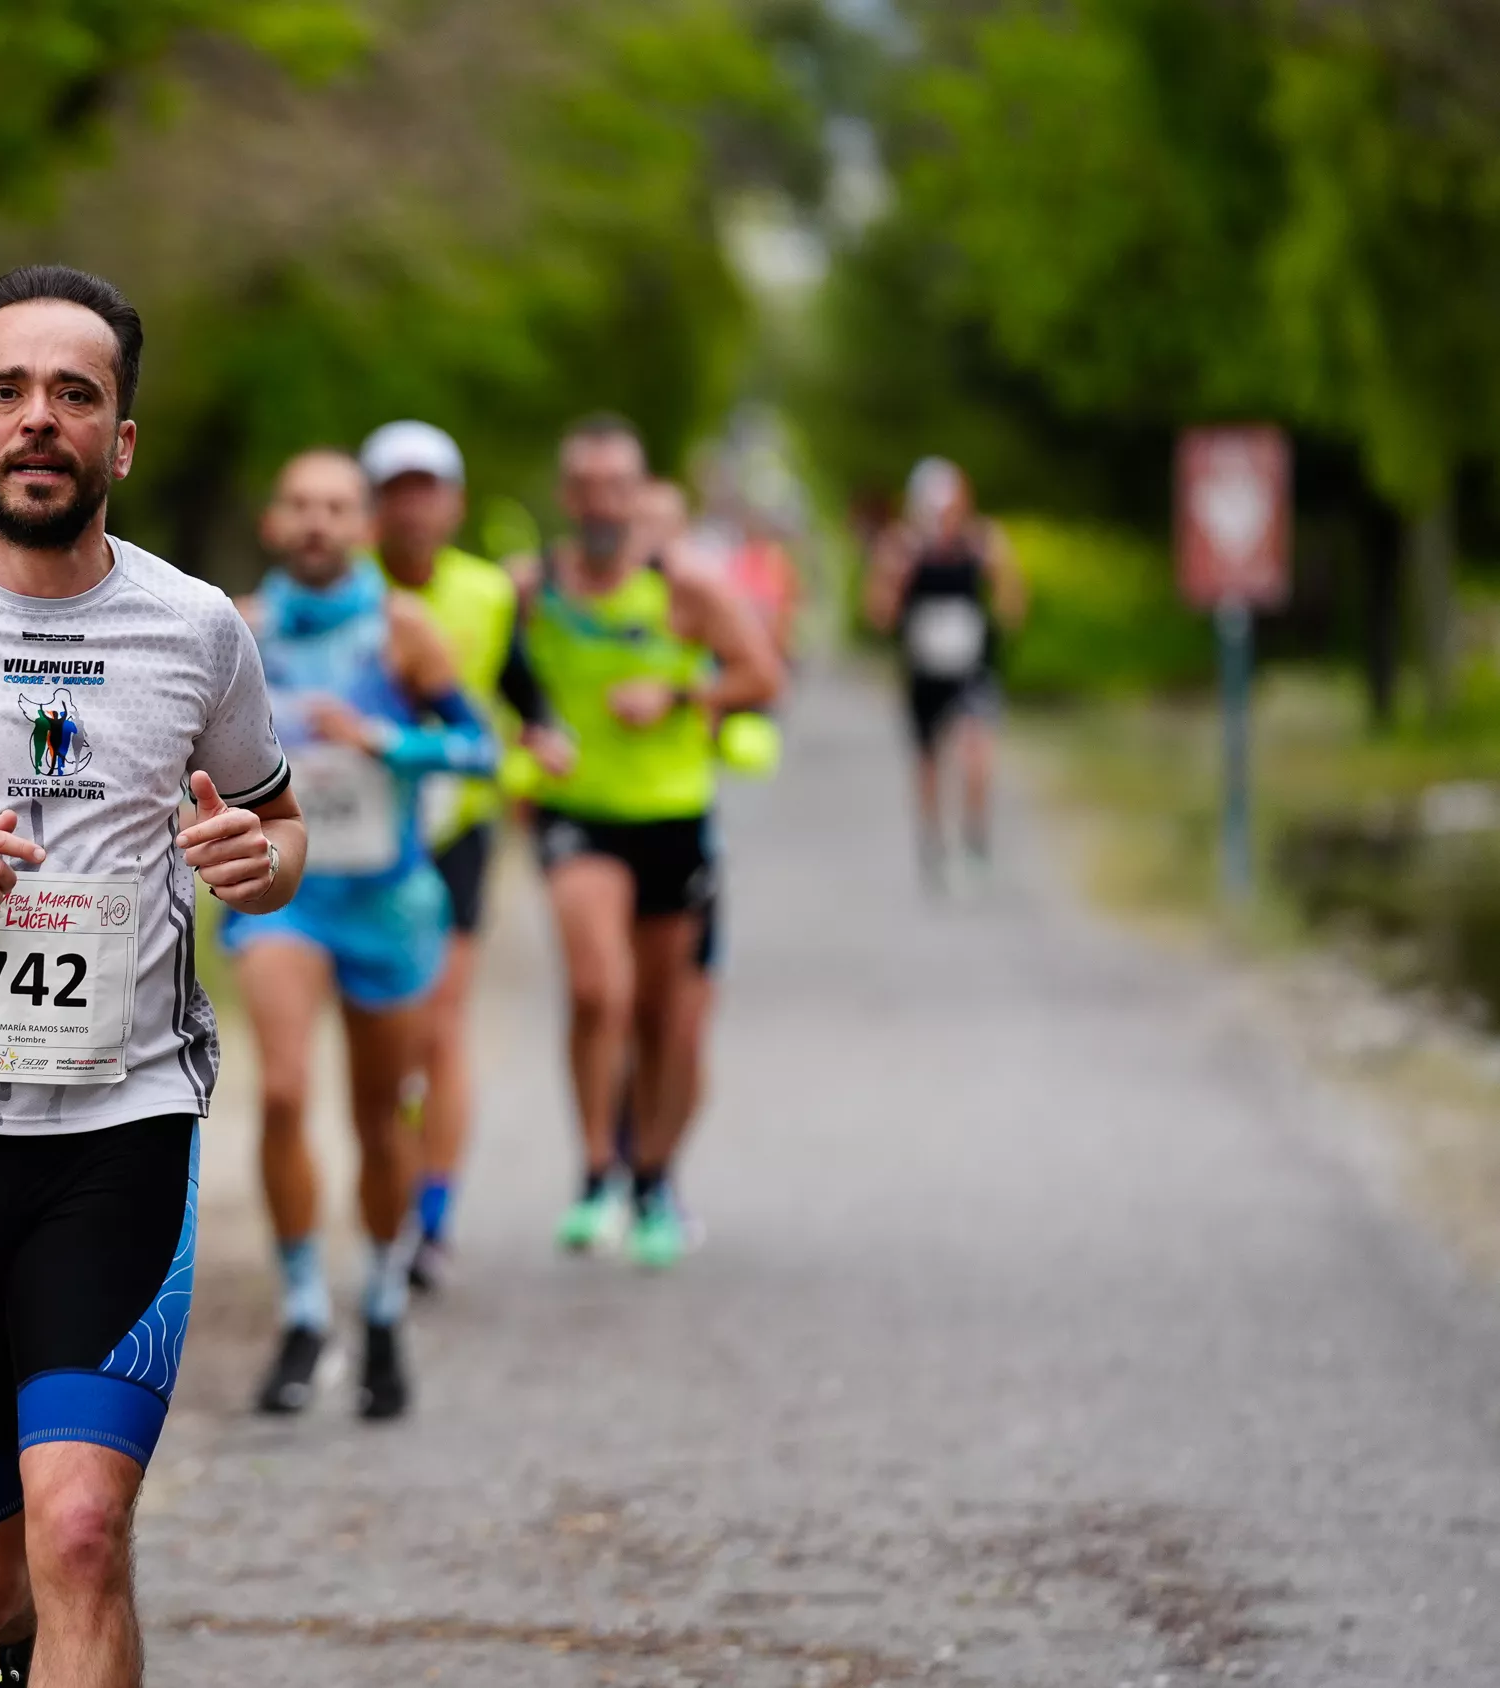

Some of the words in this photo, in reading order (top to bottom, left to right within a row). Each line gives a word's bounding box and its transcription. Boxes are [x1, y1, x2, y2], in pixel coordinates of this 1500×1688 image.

[3, 658, 105, 674] VILLANUEVA
[63, 676, 105, 685] MUCHO
[8, 778, 47, 786] VILLANUEVA
[78, 780, 105, 788] SERENA
[7, 786, 105, 800] EXTREMADURA
[37, 891, 93, 909] MARATÓN
[5, 907, 77, 932] LUCENA
[0, 1022, 27, 1032] MARÍA
[28, 1025, 58, 1033] RAMOS
[60, 1025, 89, 1034] SANTOS
[7, 1035, 47, 1044] S-Hombre
